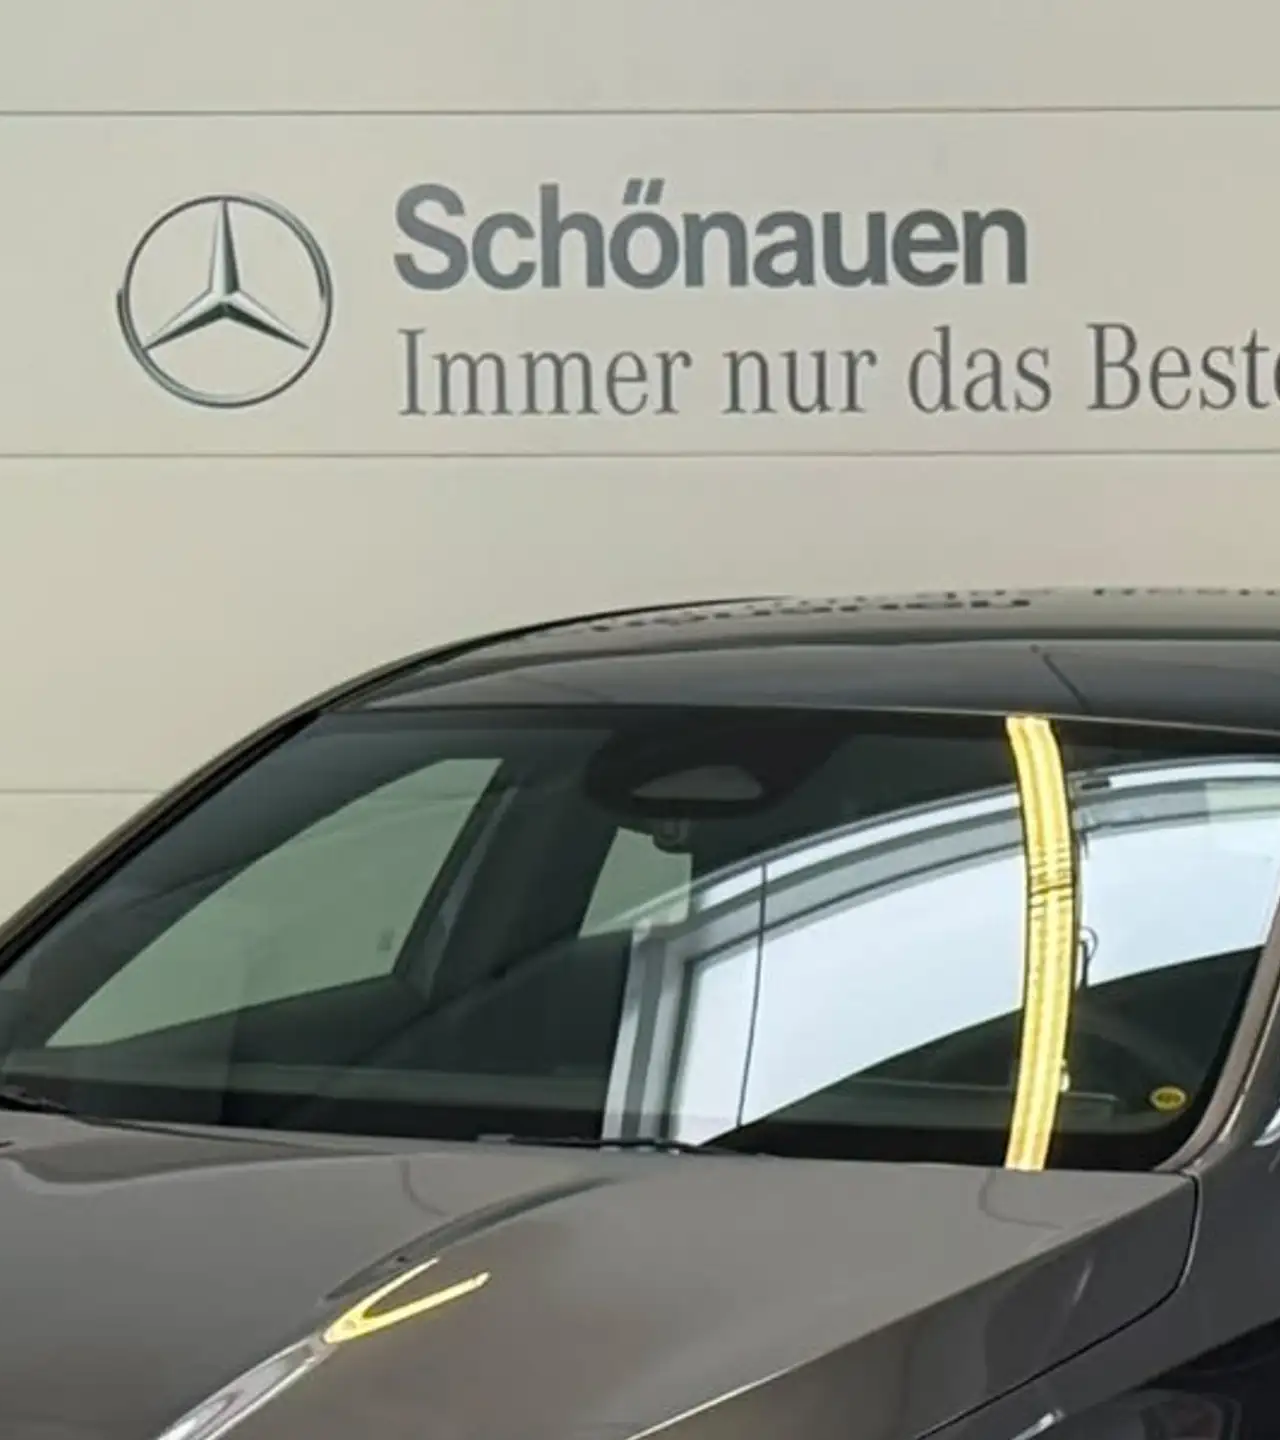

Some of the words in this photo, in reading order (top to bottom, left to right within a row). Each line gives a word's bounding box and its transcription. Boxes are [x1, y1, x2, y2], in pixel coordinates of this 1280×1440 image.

[394, 177, 1028, 291] Schönauen
[399, 329, 692, 416] Immer
[722, 349, 878, 414] nur
[908, 324, 1052, 414] das
